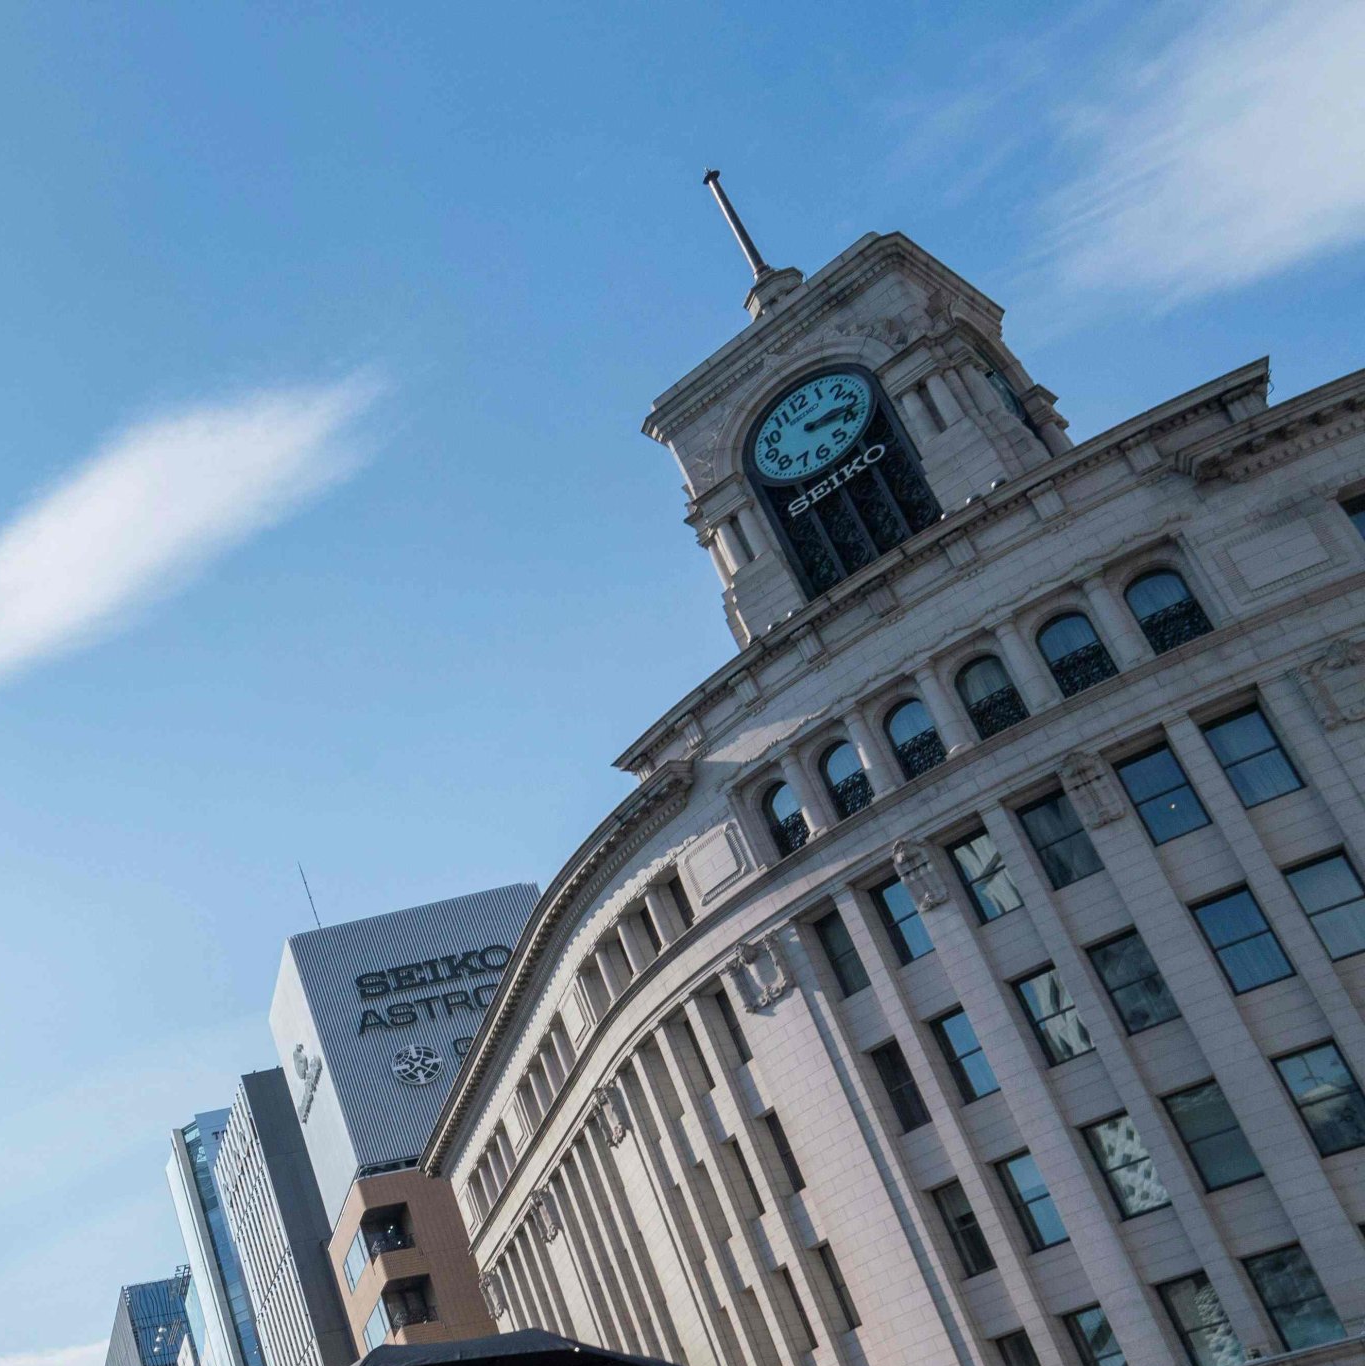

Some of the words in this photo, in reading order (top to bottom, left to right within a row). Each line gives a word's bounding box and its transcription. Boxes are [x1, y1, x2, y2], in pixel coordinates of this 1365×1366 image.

[813, 386, 823, 400] 1
[829, 383, 844, 401] 2
[788, 394, 809, 414] 12
[773, 410, 789, 429] 11
[763, 430, 782, 448] 10
[831, 428, 847, 445] 5
[764, 447, 780, 463] 9
[796, 450, 809, 468] 7
[815, 444, 831, 461] 6
[777, 454, 793, 471] 8
[788, 444, 885, 517] SEIKO
[355, 944, 513, 1000] SEIKO
